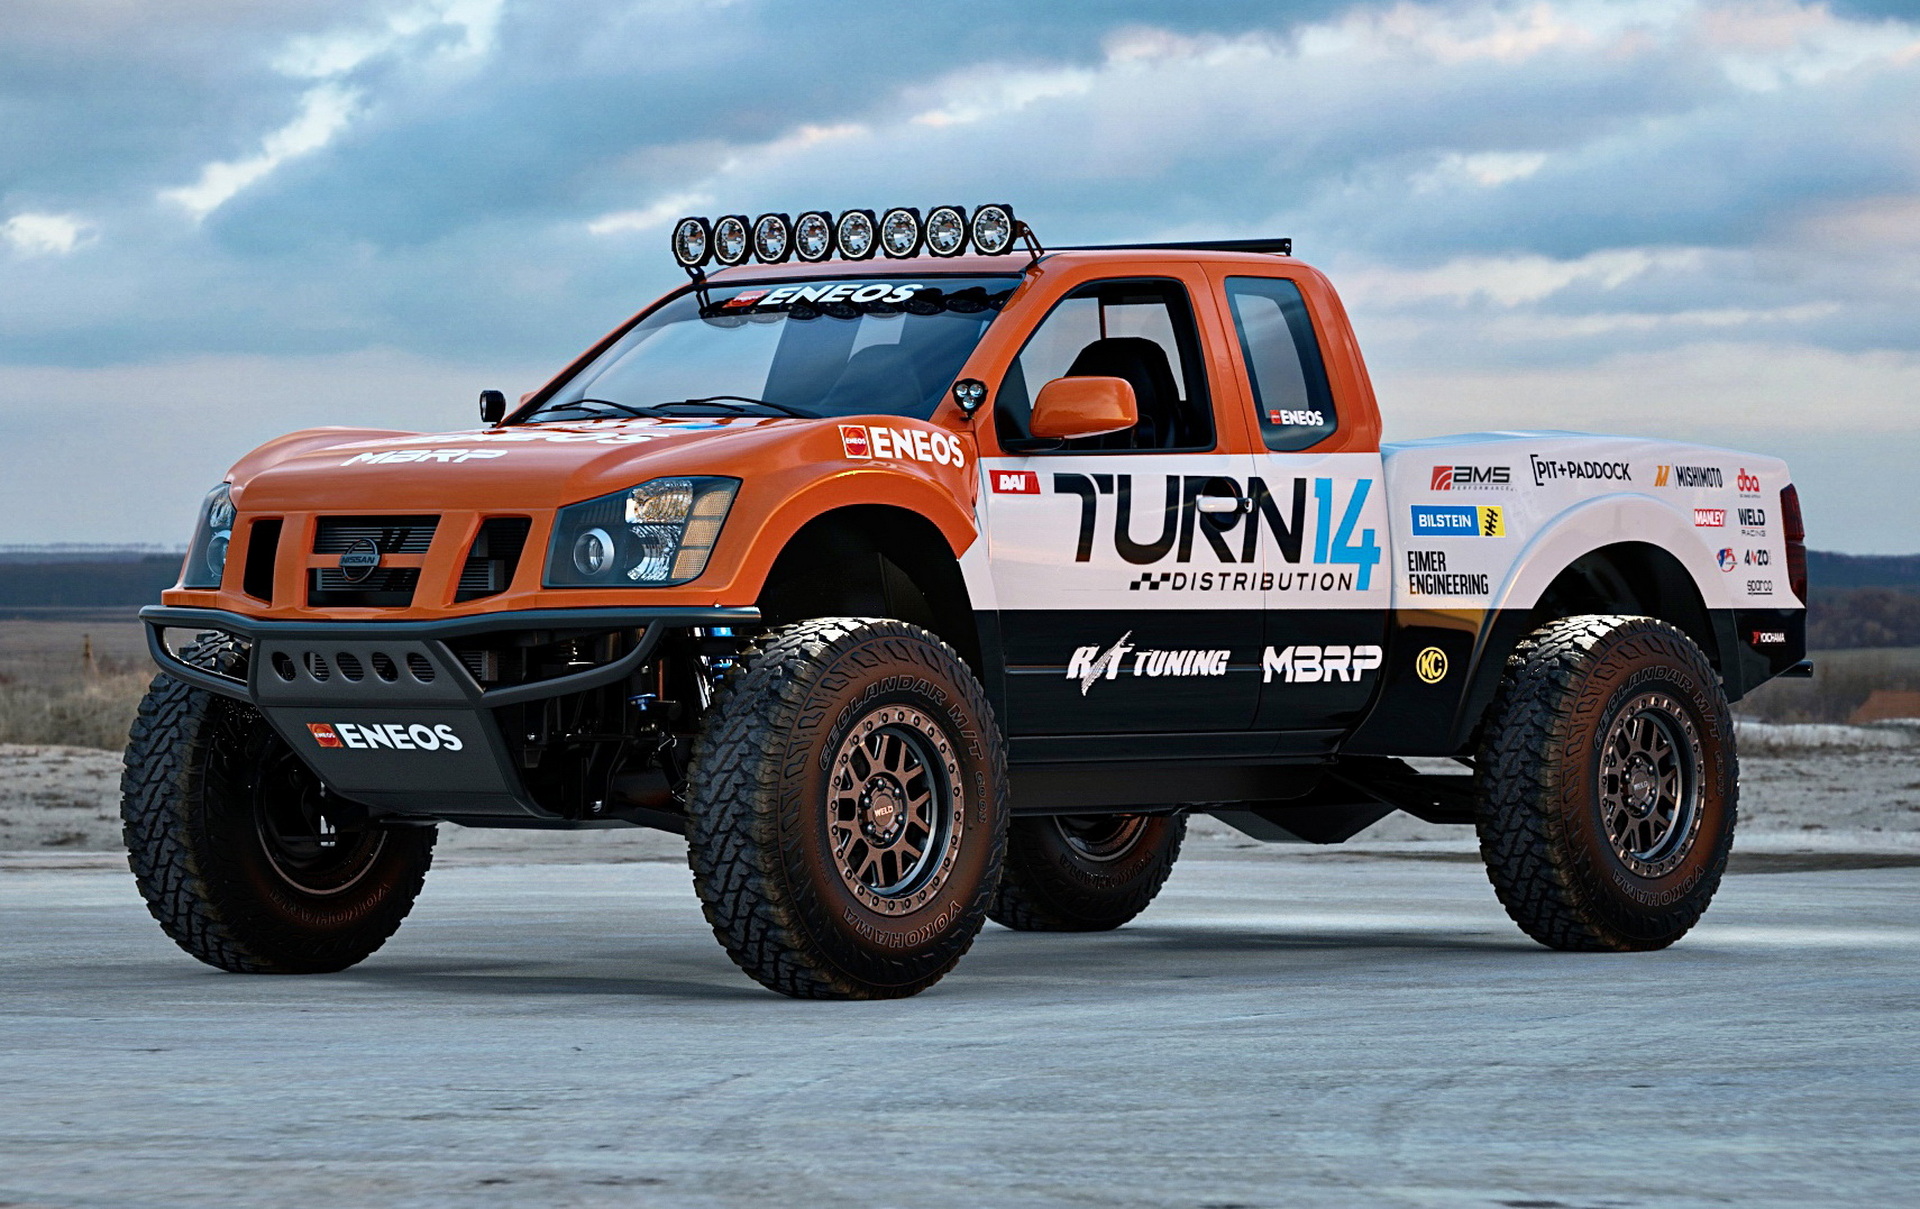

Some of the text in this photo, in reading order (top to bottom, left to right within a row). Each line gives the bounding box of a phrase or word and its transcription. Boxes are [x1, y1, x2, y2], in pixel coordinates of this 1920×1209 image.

[758, 284, 923, 305] ENEOS
[1281, 410, 1324, 426] ENEOS
[340, 449, 508, 466] MBRP
[869, 427, 964, 468] ENEOS
[1000, 475, 1026, 491] DAI
[1453, 466, 1510, 483] AMS
[1675, 465, 1723, 488] MISHIMOTO
[1737, 468, 1760, 492] dba
[1418, 514, 1471, 527] BILSTEIN
[1694, 511, 1725, 526] MANLEY
[1738, 508, 1765, 525] WELD
[1741, 529, 1766, 537] RACING
[341, 556, 376, 564] NISSAN
[1407, 551, 1447, 571] EIMER
[1171, 572, 1352, 590] DISTRIBUTION
[1409, 574, 1489, 594] ENGINEERING
[1747, 580, 1773, 595] sparco
[1133, 650, 1231, 677] TUNING
[1262, 645, 1383, 683] MBRP
[1594, 665, 1694, 750] GEOLANDAR
[819, 675, 948, 770] GEOLANDAR
[335, 723, 463, 750] ENEOS
[874, 805, 893, 817] WELD
[1612, 865, 1705, 907] YOKOHAMA
[842, 900, 962, 948] YOKOHAMA
